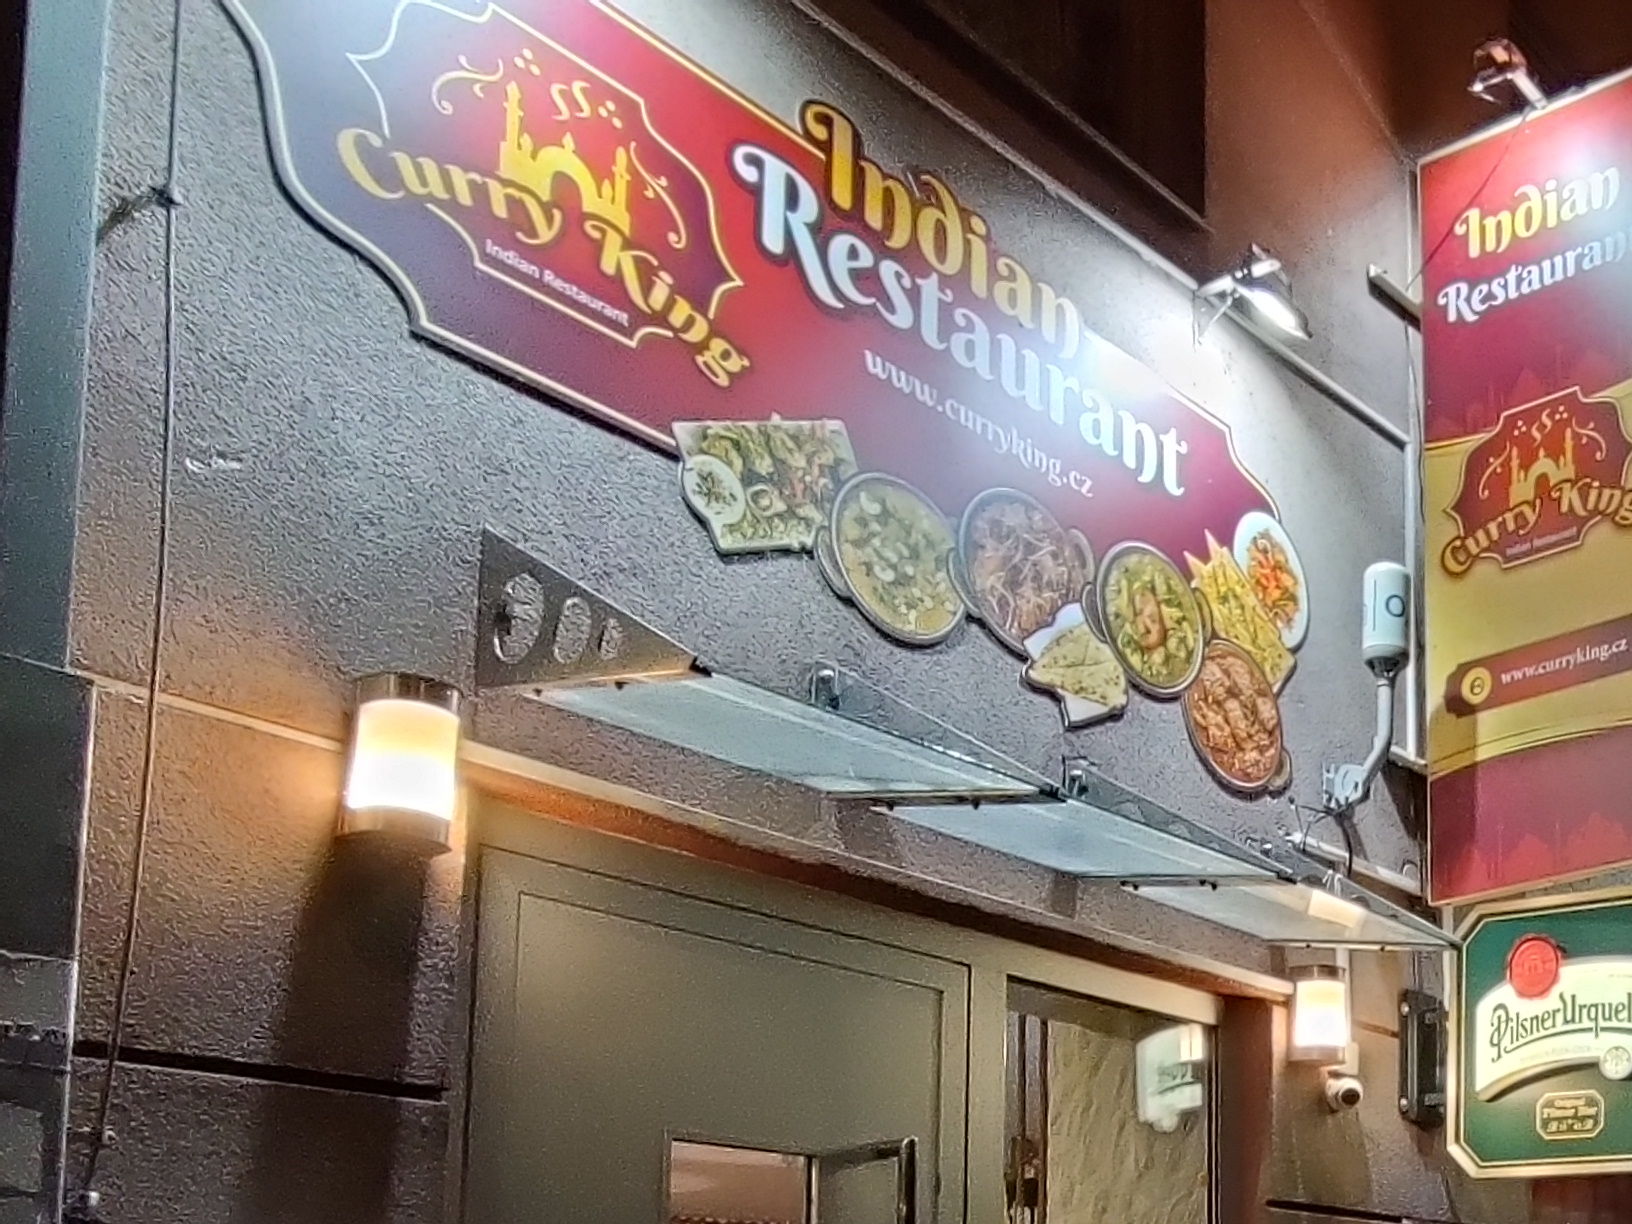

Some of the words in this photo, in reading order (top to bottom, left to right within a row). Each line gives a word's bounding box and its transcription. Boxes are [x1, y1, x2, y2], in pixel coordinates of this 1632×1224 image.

[336, 126, 562, 246] Curry
[582, 219, 752, 389] King
[804, 102, 1080, 362] Indian
[1454, 166, 1620, 259] Indian
[485, 238, 540, 279] Indian
[543, 268, 629, 327] Restaurant
[732, 144, 1188, 497] Restaurant
[864, 348, 1094, 498] www.curryking.cz
[1444, 497, 1541, 574] Curry
[1500, 637, 1629, 685] www.curryking.cz
[1489, 1002, 1562, 1063] Pilsner
